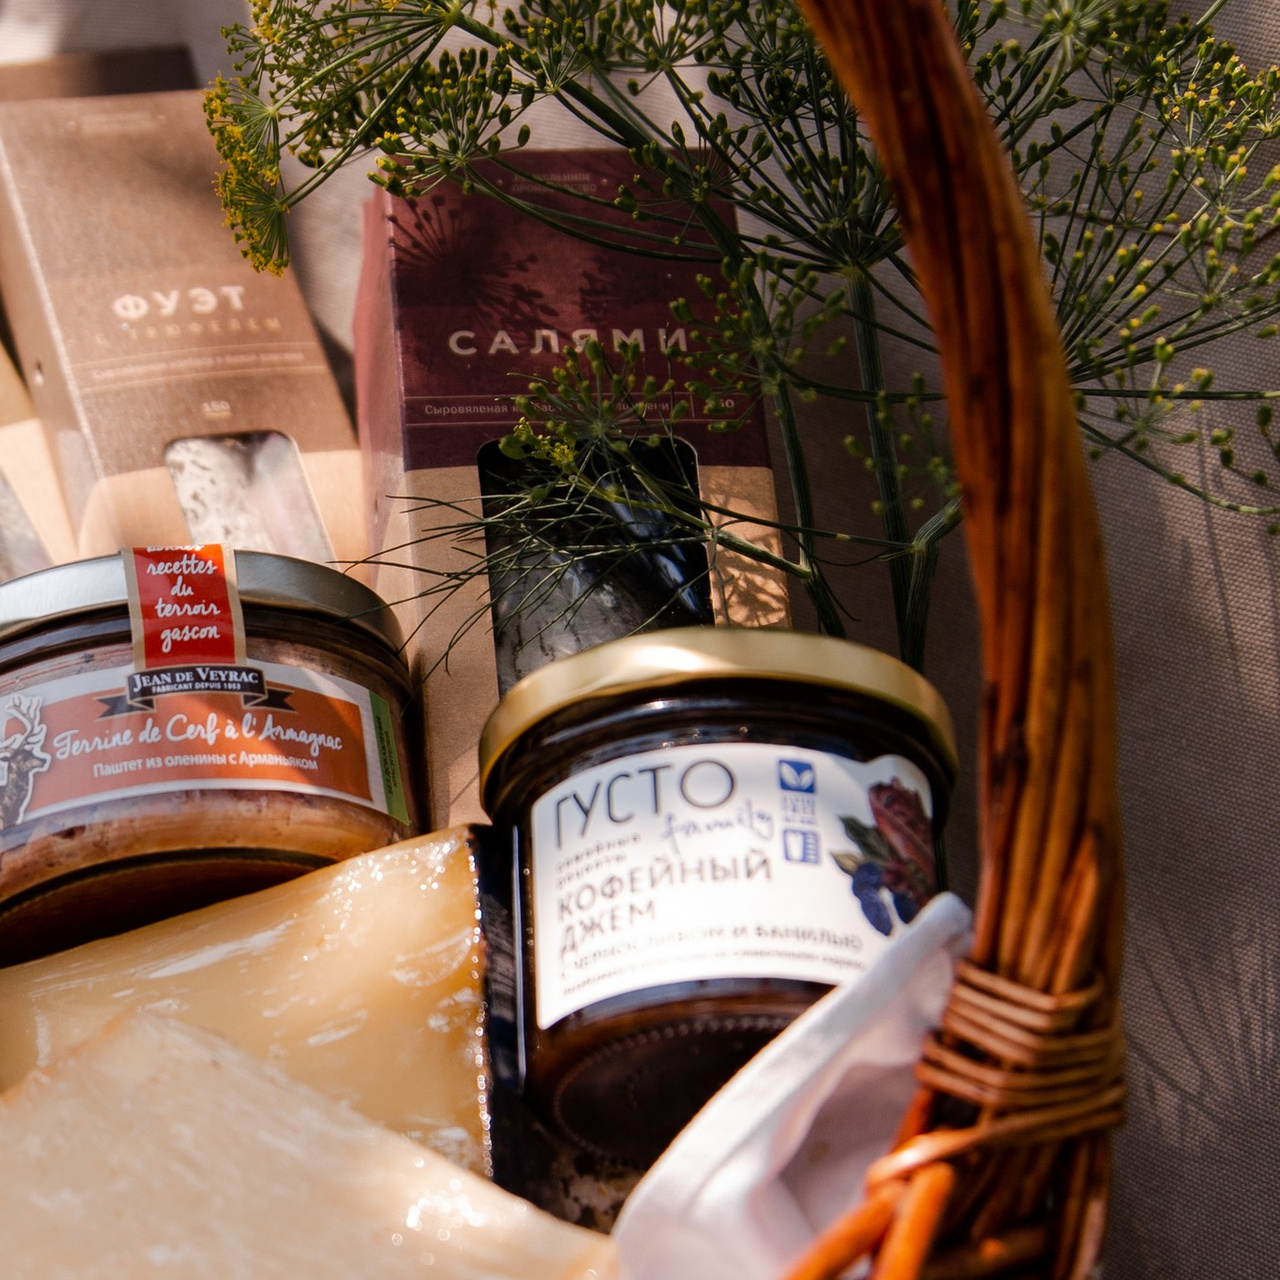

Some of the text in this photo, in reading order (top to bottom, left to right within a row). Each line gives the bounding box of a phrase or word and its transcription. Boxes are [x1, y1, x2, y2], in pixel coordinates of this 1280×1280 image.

[113, 285, 246, 320] ФУЭТ
[448, 328, 688, 355] САЛЯМИ
[424, 404, 509, 416] Сыровяленая
[146, 553, 218, 575] recettes
[170, 575, 195, 597] du
[154, 597, 221, 618] terroir
[160, 625, 221, 653] gascon
[132, 667, 259, 692] JEAN DE VEYRAC
[151, 682, 193, 694] FABRICANT
[194, 681, 222, 690] DEPUIS
[52, 728, 135, 760] Terrine
[138, 717, 162, 744] de
[165, 712, 221, 746] Cerf
[224, 719, 239, 739] à
[93, 750, 319, 778] Паштет из оленины с Арманьяком
[556, 759, 736, 850] ГУСТО
[558, 848, 774, 922] КОФЕЙНЫЙ
[559, 899, 655, 959] ДЖЕМ
